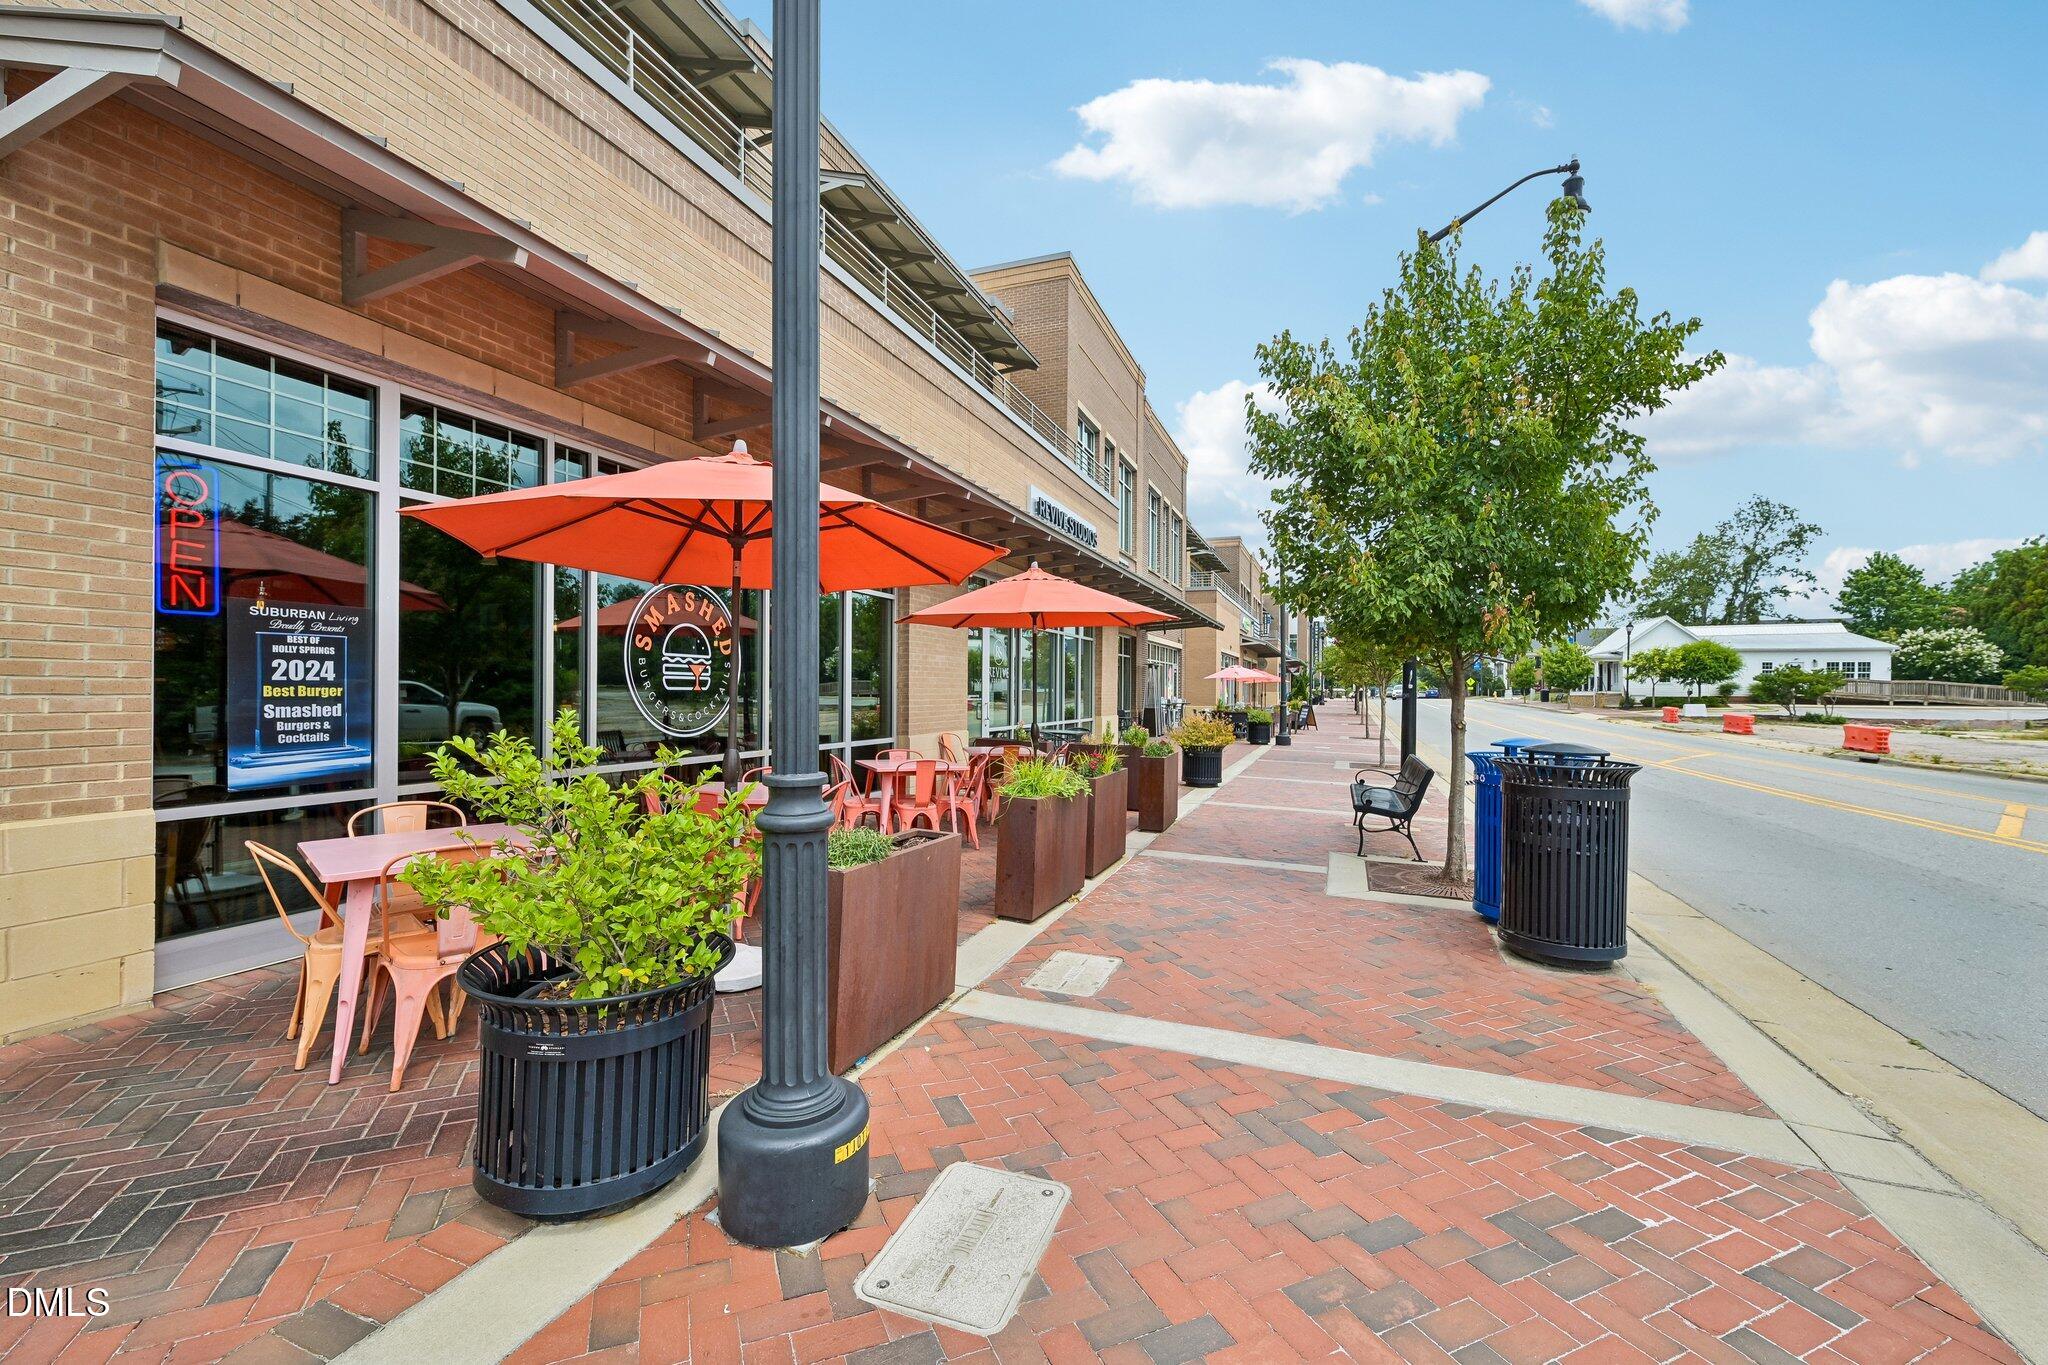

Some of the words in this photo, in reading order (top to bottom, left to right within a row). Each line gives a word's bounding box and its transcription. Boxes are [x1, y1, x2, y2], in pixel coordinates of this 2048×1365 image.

[165, 470, 209, 608] OPEN
[249, 605, 326, 620] SUBURBAN
[328, 612, 359, 625] Living
[268, 619, 306, 634] Proudly
[310, 621, 346, 633] Presents
[635, 591, 732, 656] SMASHED
[286, 635, 308, 644] BEST
[309, 636, 320, 645] OF
[272, 644, 298, 654] HOLLY
[299, 645, 336, 655] SPRINGS
[271, 658, 336, 682] 2024
[262, 685, 295, 697] Best
[297, 685, 343, 698] Burger
[263, 703, 342, 719] Smashed
[276, 721, 322, 732] Burgers
[323, 721, 331, 730] &
[277, 732, 330, 744] Cocktails
